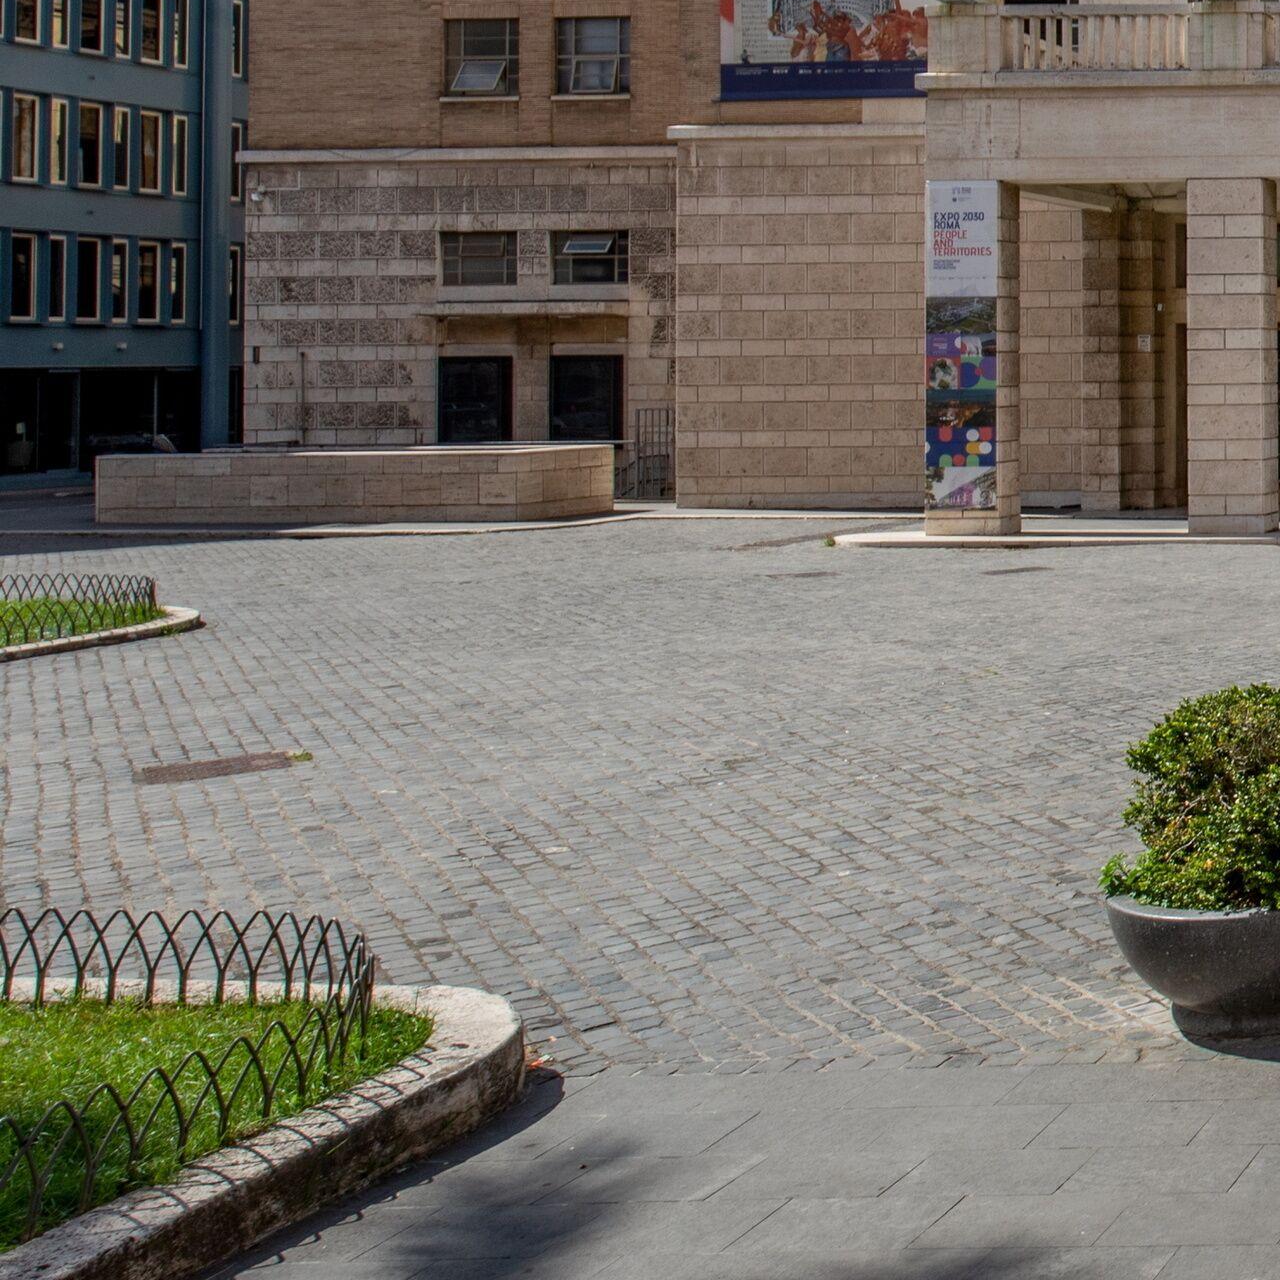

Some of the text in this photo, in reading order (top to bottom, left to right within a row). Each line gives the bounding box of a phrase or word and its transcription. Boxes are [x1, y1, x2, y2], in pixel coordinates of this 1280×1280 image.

[933, 211, 985, 221] EXPO 2030
[933, 221, 960, 229] ROMA
[933, 230, 967, 239] PEOPLE
[933, 239, 953, 247] AND
[933, 247, 992, 256] TERRITORIES
